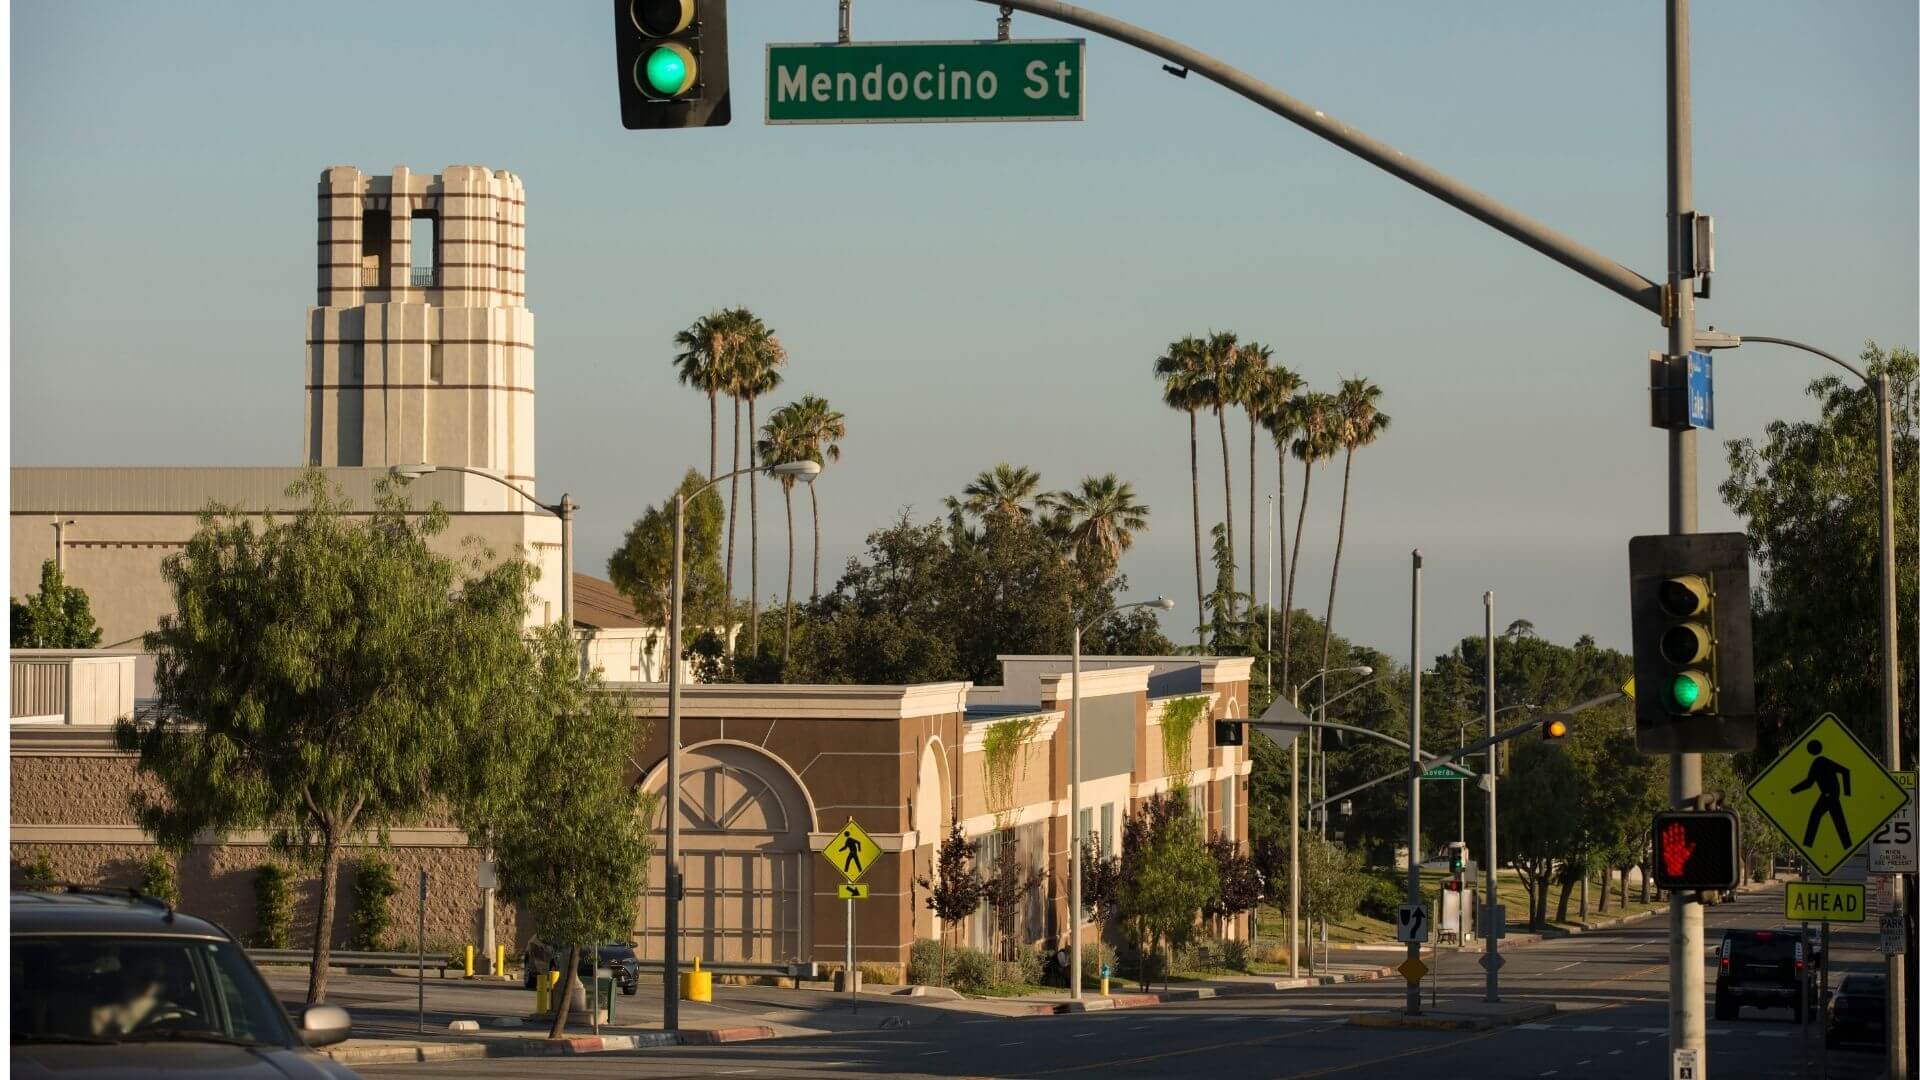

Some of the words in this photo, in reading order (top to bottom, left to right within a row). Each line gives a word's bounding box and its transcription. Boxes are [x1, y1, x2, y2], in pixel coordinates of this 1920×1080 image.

[777, 63, 998, 102] Mendocino
[1023, 60, 1072, 99] St
[1873, 821, 1912, 844] 25
[1794, 892, 1857, 912] AHEAD
[1881, 917, 1904, 929] PARK
